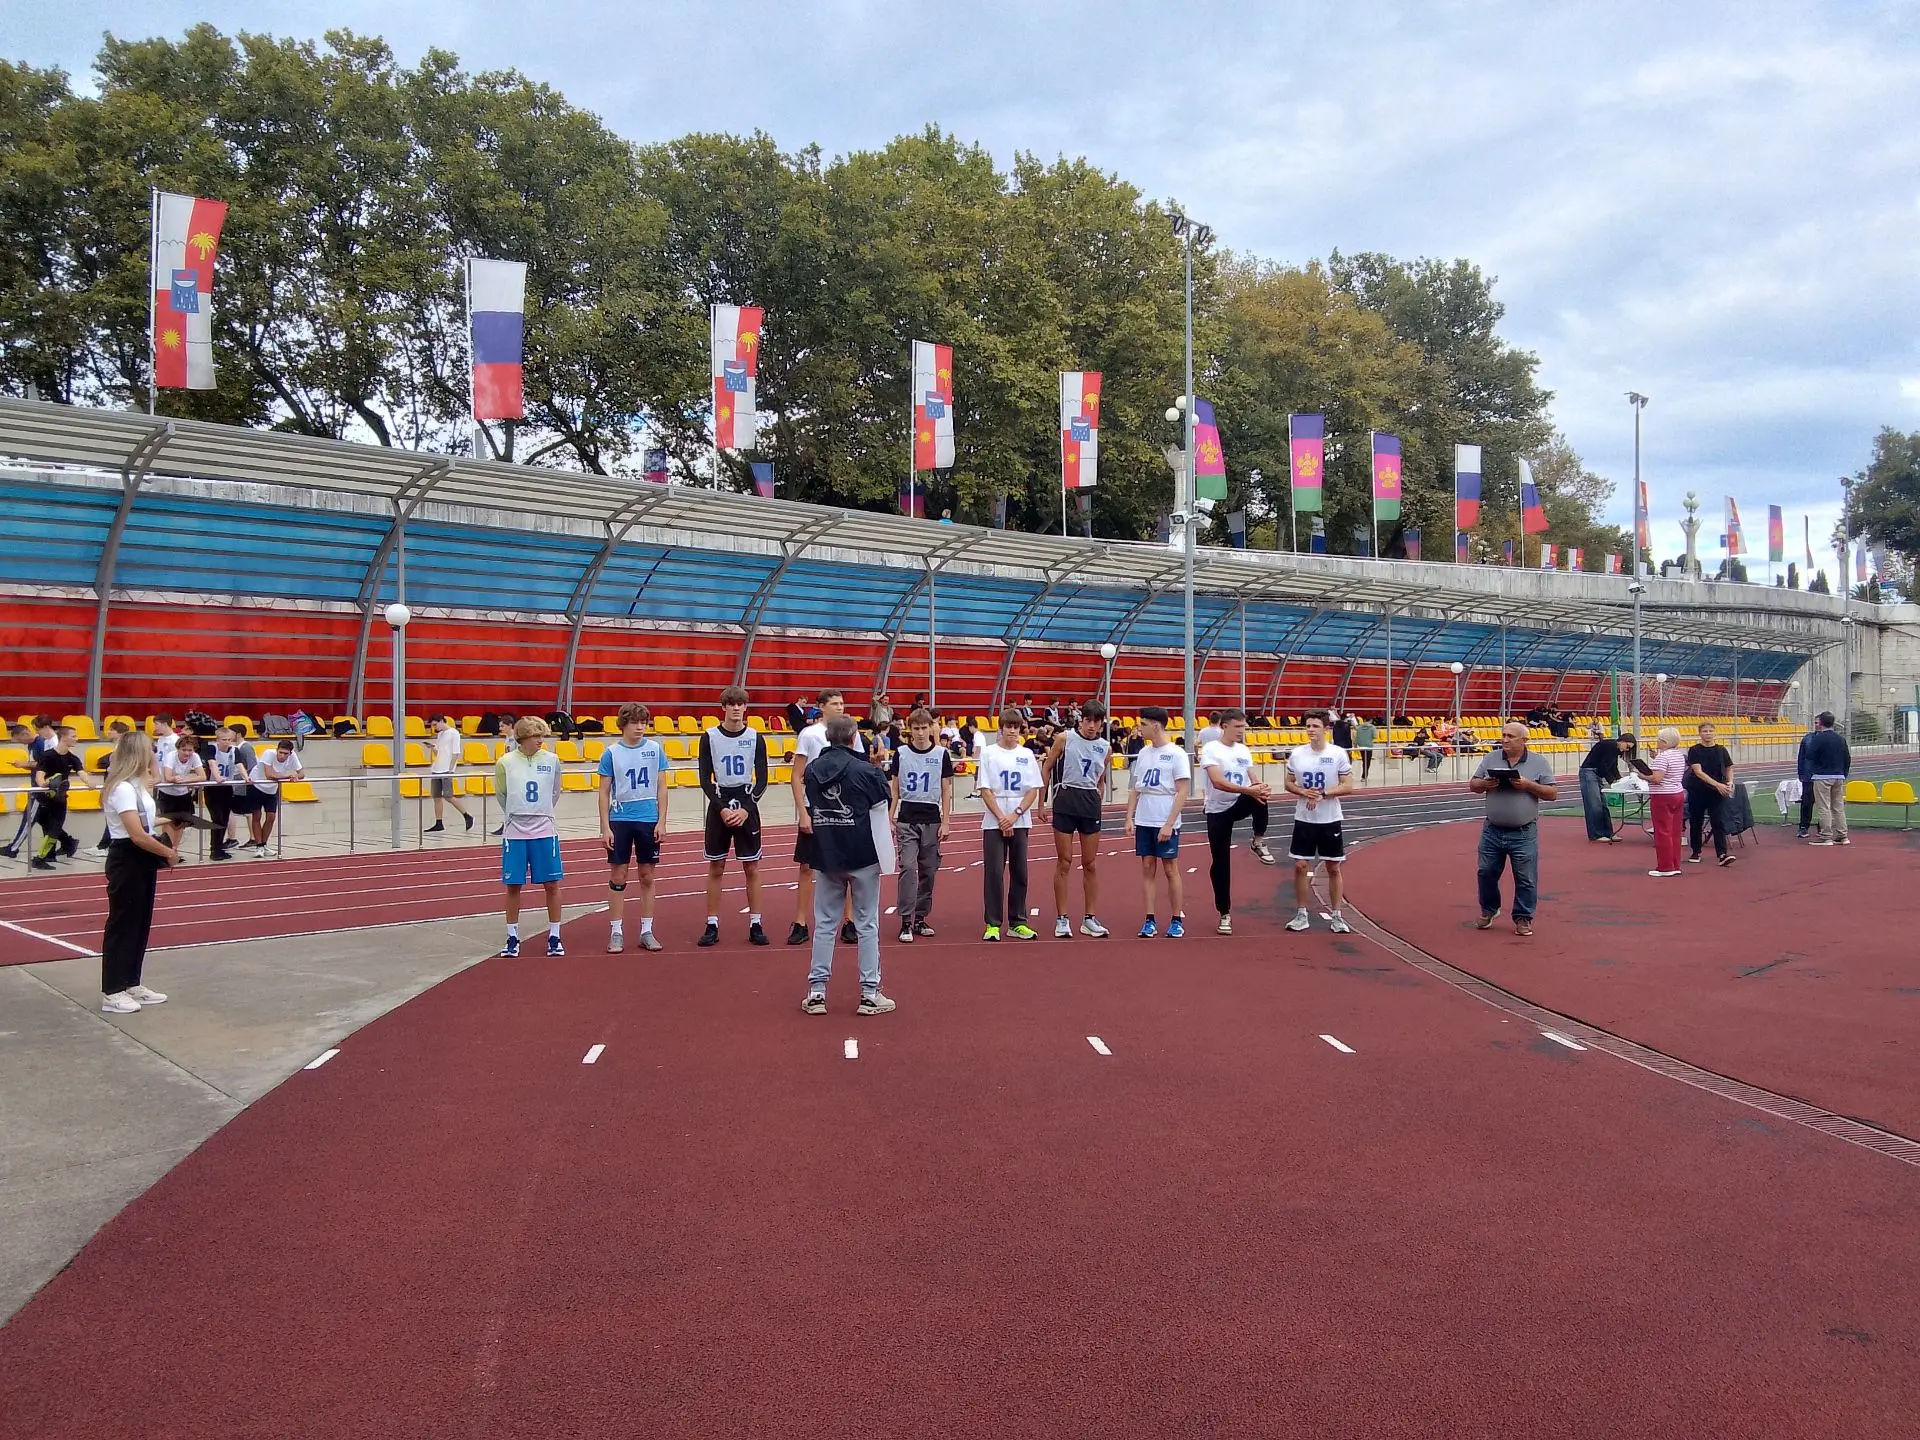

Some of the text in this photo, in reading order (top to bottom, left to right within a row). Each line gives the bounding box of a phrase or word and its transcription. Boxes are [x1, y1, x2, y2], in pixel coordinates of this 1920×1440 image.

[721, 755, 744, 776] 16
[1081, 758, 1093, 777] 7
[625, 766, 650, 790] 14
[906, 772, 930, 793] 31
[1000, 770, 1021, 791] 12
[1142, 768, 1161, 787] 40
[1303, 771, 1326, 790] 38
[525, 781, 539, 803] 8
